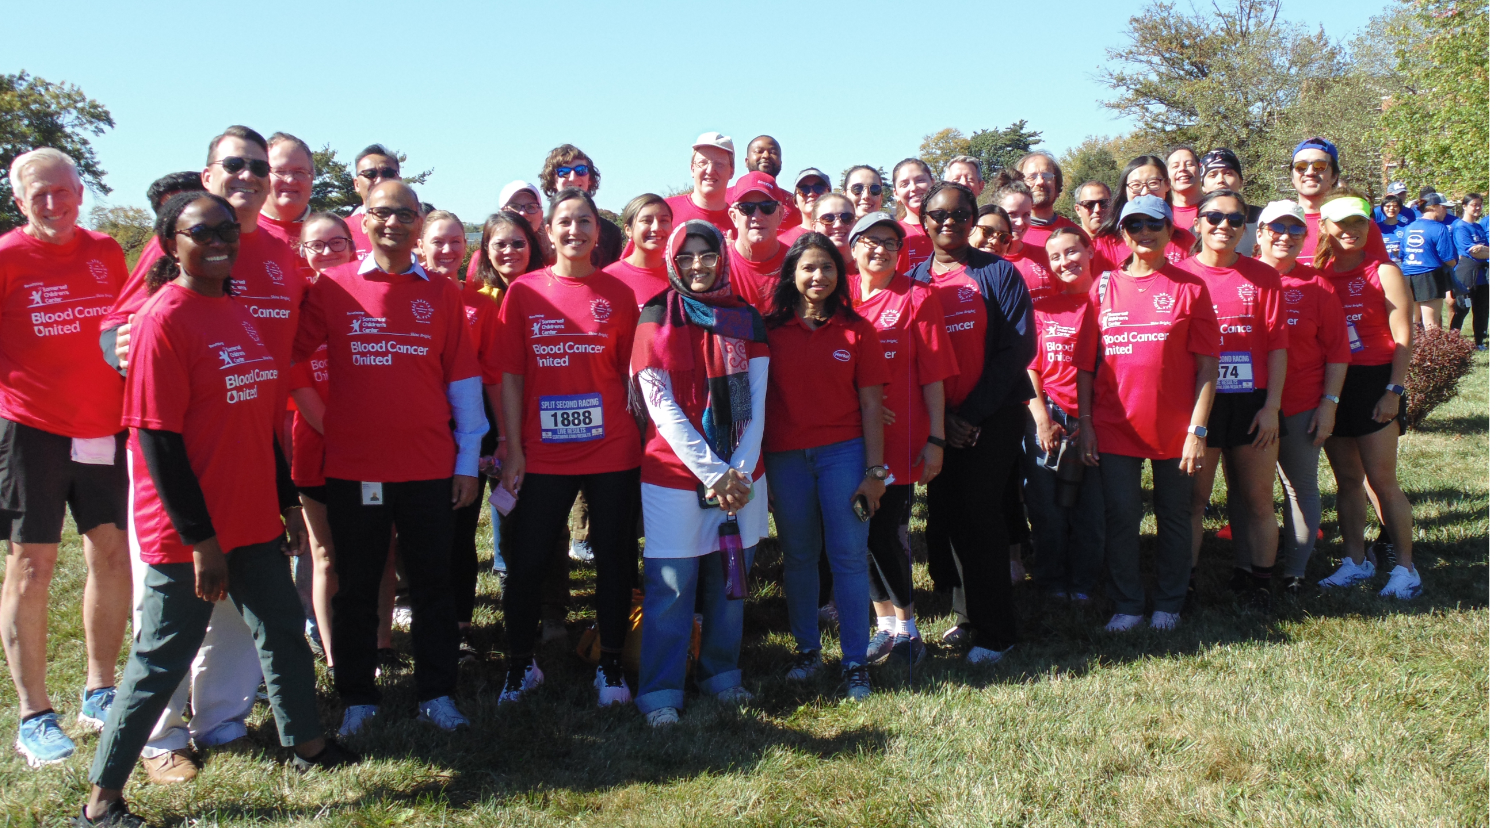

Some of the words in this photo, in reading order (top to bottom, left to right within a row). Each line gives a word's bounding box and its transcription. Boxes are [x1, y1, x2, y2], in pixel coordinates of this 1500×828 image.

[32, 308, 73, 324] Blood
[75, 306, 114, 318] Cance
[250, 306, 290, 318] Cancer
[1346, 313, 1362, 321] cer
[34, 321, 80, 336] United
[1220, 324, 1252, 334] Cance
[1129, 332, 1169, 342] Cancer
[350, 340, 386, 352] Blood
[388, 341, 428, 355] Cancer
[566, 342, 606, 353] Cancer
[1046, 342, 1074, 352] Blood
[1105, 344, 1132, 356] nited
[353, 354, 392, 365] United
[537, 356, 568, 367] nited
[1048, 352, 1072, 362] Unite
[1218, 366, 1239, 378] 74
[226, 370, 254, 389] Blood
[255, 368, 278, 382] Cance
[226, 386, 258, 404] United
[556, 400, 578, 408] SECOND
[578, 398, 599, 407] RACING
[551, 410, 592, 427] 1888
